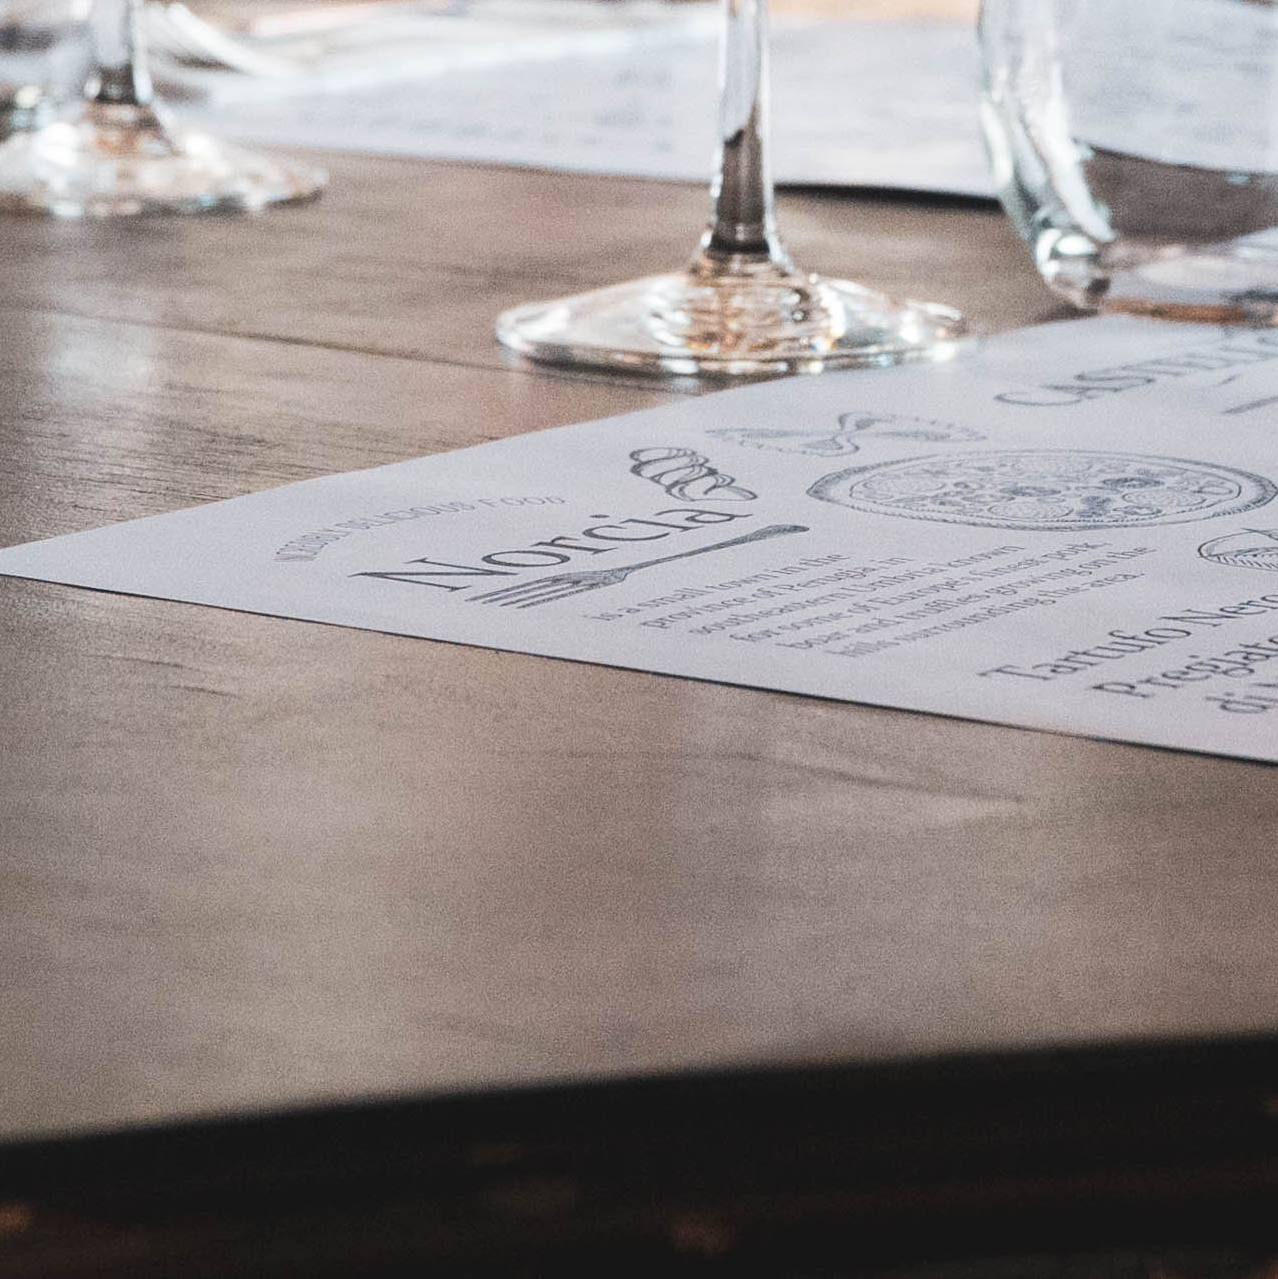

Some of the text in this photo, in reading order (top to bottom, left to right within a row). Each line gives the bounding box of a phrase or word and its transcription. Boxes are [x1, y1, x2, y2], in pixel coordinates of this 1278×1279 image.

[478, 496, 566, 508] FOOD
[349, 506, 755, 594] Norcia
[617, 606, 643, 614] a
[637, 587, 711, 608] small
[764, 565, 808, 575] in
[798, 553, 849, 567] the
[639, 596, 754, 629] province
[750, 587, 785, 598] of
[870, 556, 913, 565] in
[849, 617, 903, 633] and
[1078, 558, 1117, 571] on
[1106, 546, 1156, 560] the
[729, 628, 781, 643] for
[847, 601, 880, 613] of
[979, 626, 1193, 681] Tartufo
